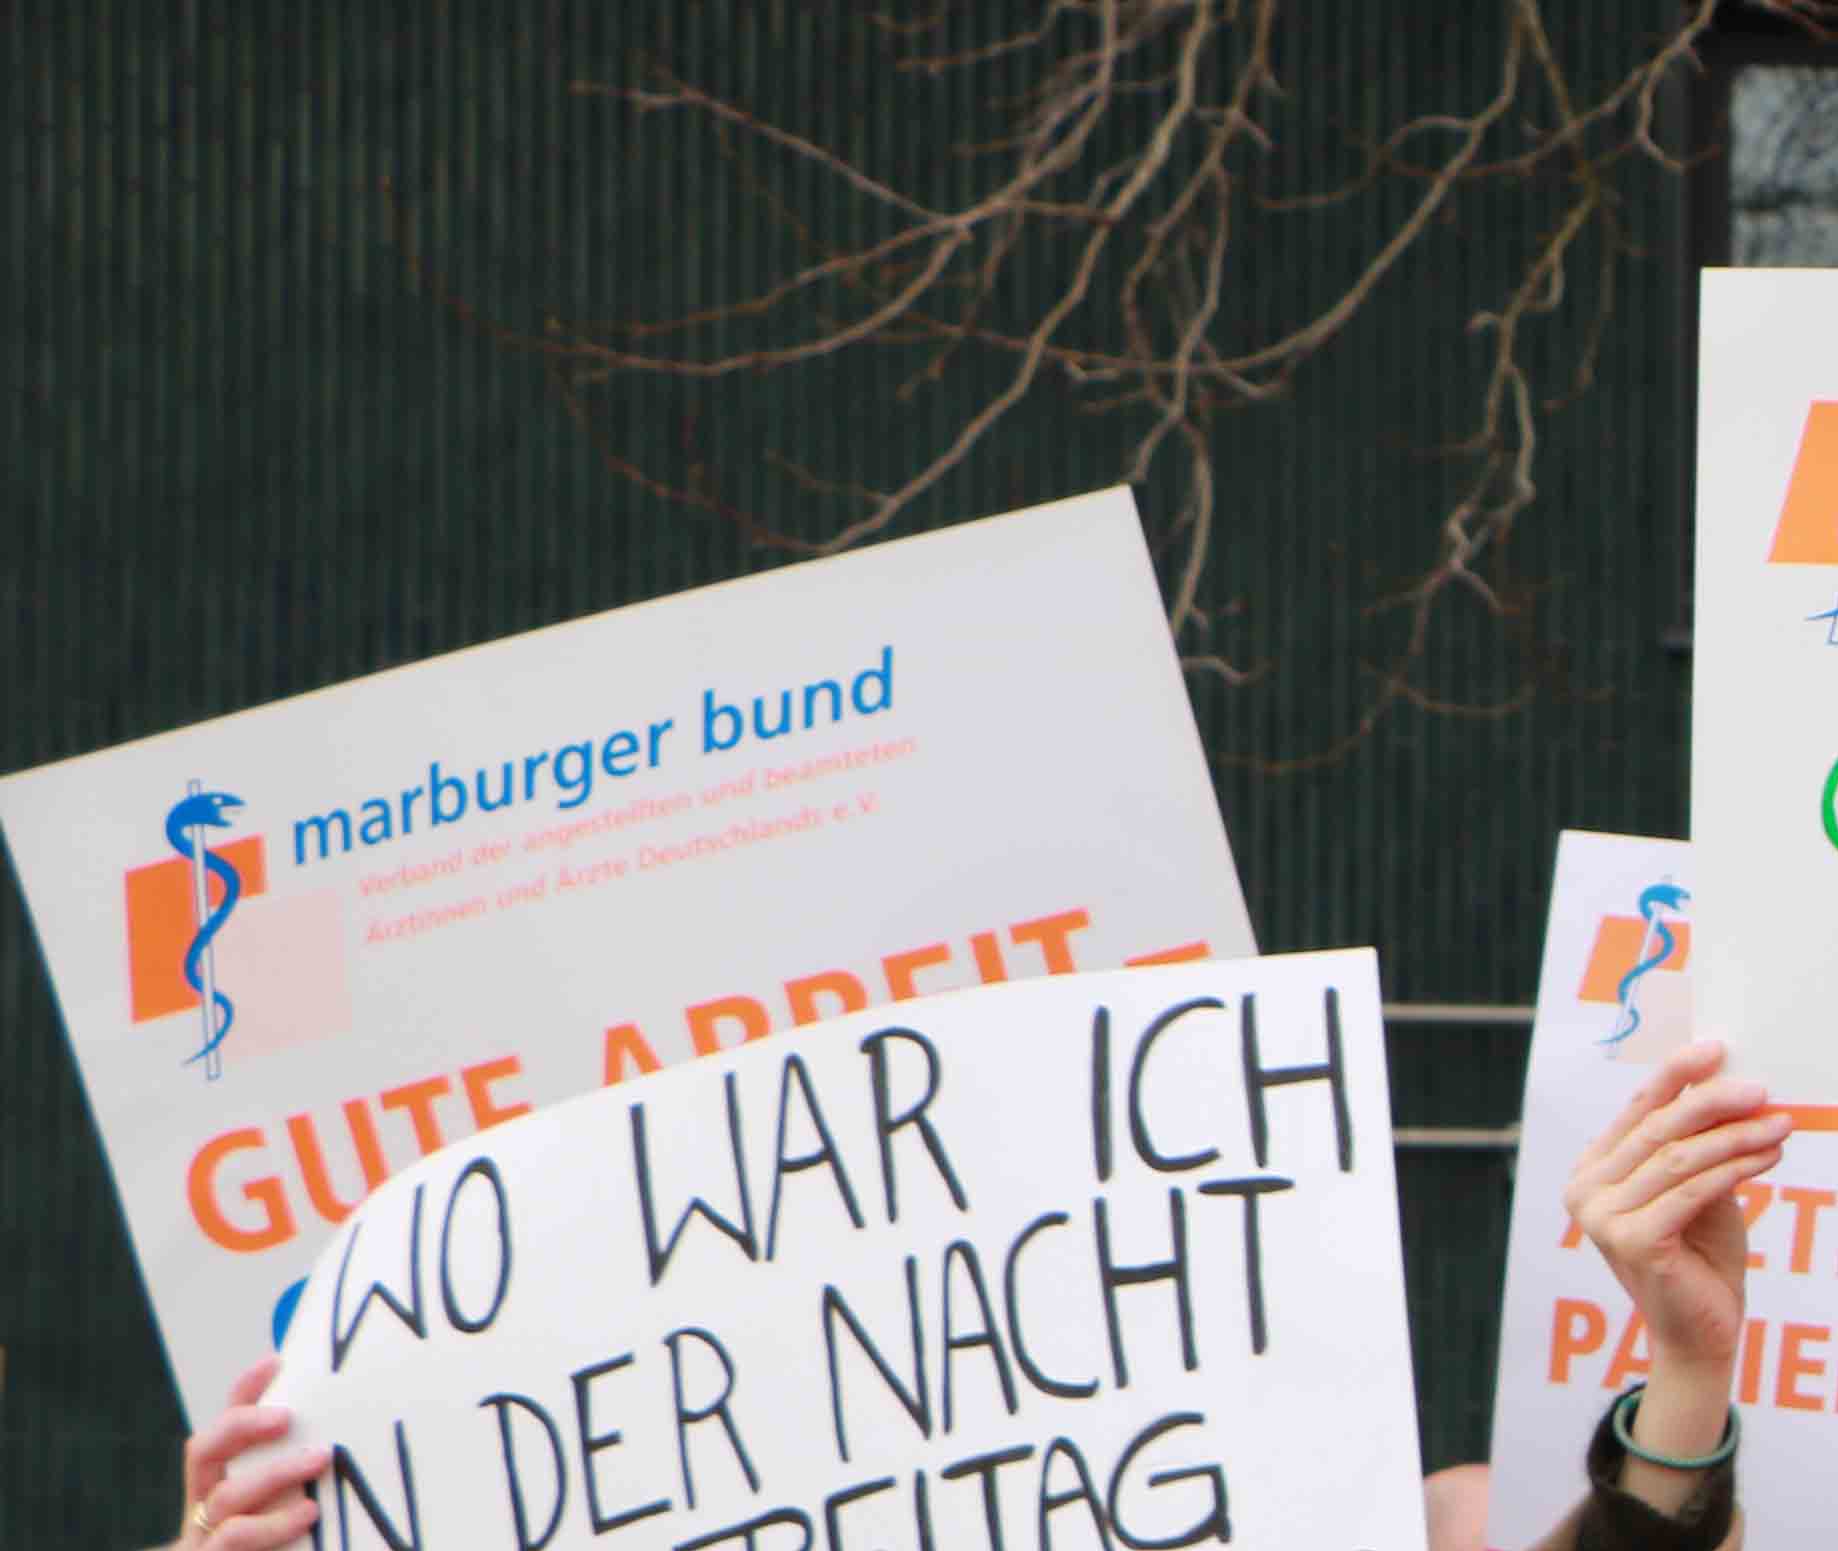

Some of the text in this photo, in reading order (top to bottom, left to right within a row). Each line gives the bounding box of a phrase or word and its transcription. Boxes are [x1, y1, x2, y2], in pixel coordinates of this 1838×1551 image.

[293, 646, 894, 866] marburger bund
[471, 839, 511, 867] der
[701, 774, 756, 805] und
[496, 876, 547, 911] und
[185, 1056, 535, 1254] GUTE
[333, 987, 1355, 1371] WO WAR ICH
[823, 1175, 1295, 1463] NACHT
